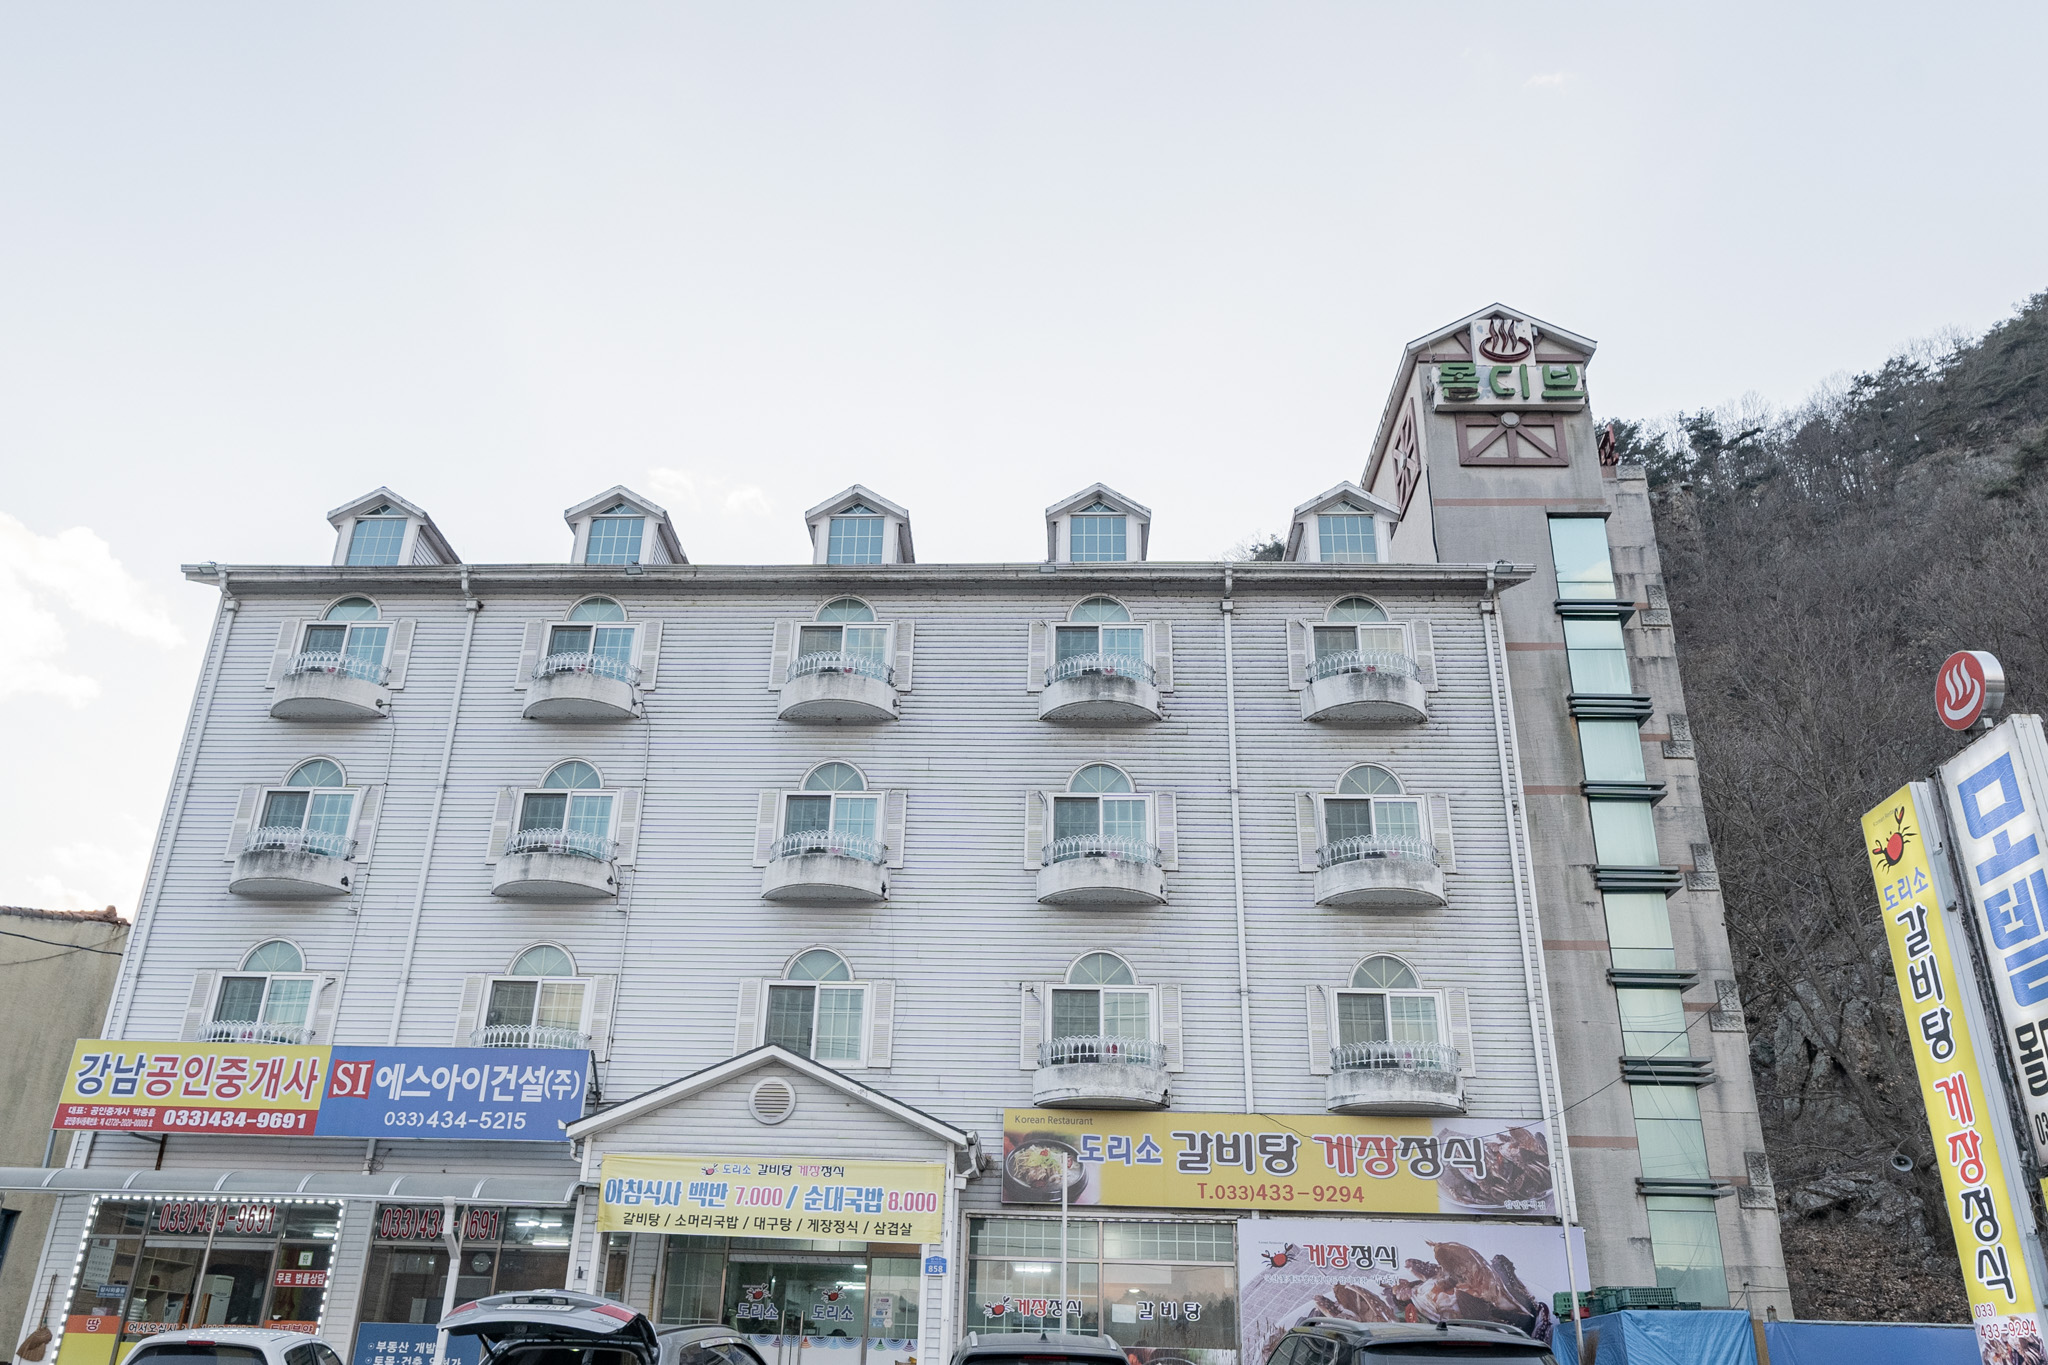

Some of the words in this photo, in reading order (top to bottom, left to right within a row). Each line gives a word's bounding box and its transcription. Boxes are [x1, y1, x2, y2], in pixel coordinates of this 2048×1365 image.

[1439, 362, 1585, 401] 몰디브
[1883, 866, 1929, 912] 도리소
[1957, 751, 2048, 1007] 모텔
[1896, 902, 1956, 1064] 갈비탕
[77, 1053, 319, 1101] 강남공인중개사
[332, 1062, 374, 1096] SI
[375, 1063, 581, 1102] 에스아이건설(주)
[90, 1107, 131, 1116] 공인중개사
[162, 1109, 307, 1129] 033)434-9691
[384, 1110, 527, 1130] 033)434-5215
[1014, 1115, 1046, 1125] Korean
[1047, 1116, 1094, 1126] Restaurant
[1077, 1134, 1163, 1166] 도리소
[1171, 1131, 1301, 1176] 갈비탕
[1311, 1134, 1487, 1180] 게장정식
[722, 1164, 751, 1175] 도리소
[757, 1164, 793, 1177] 갈비탕
[797, 1165, 845, 1178] 게장정식
[605, 1178, 682, 1207] 아침식사
[688, 1181, 729, 1208] 백반
[735, 1186, 783, 1206] 7.000
[804, 1185, 885, 1214] 순대국밥
[888, 1191, 937, 1213] 8.000
[1197, 1183, 1365, 1204] T.033)433-9294
[1933, 1071, 2017, 1304] 게장정식
[159, 1202, 277, 1234] 033)434-9691
[623, 1212, 661, 1227] 갈비탕
[674, 1214, 739, 1229] 소머리국밥
[753, 1216, 793, 1232] 대구탕
[807, 1219, 859, 1234] 게장정식
[873, 1221, 913, 1236] 삼겹살
[1302, 1244, 1399, 1271] 게장정식
[276, 1272, 292, 1284] 무료
[295, 1273, 326, 1285] 법률상담
[928, 1265, 943, 1273] 858
[736, 1303, 779, 1320] 도리소
[811, 1304, 854, 1322] 도리소
[1014, 1298, 1083, 1319] 게장정식
[1137, 1301, 1202, 1322] 갈비탕
[1974, 1302, 1997, 1318] 033)
[86, 1318, 101, 1332] 땅
[128, 1322, 187, 1338] 어서오십시
[1980, 1320, 2037, 1339] 433-9294
[376, 1341, 409, 1354] 부동산
[414, 1342, 437, 1355] 개발
